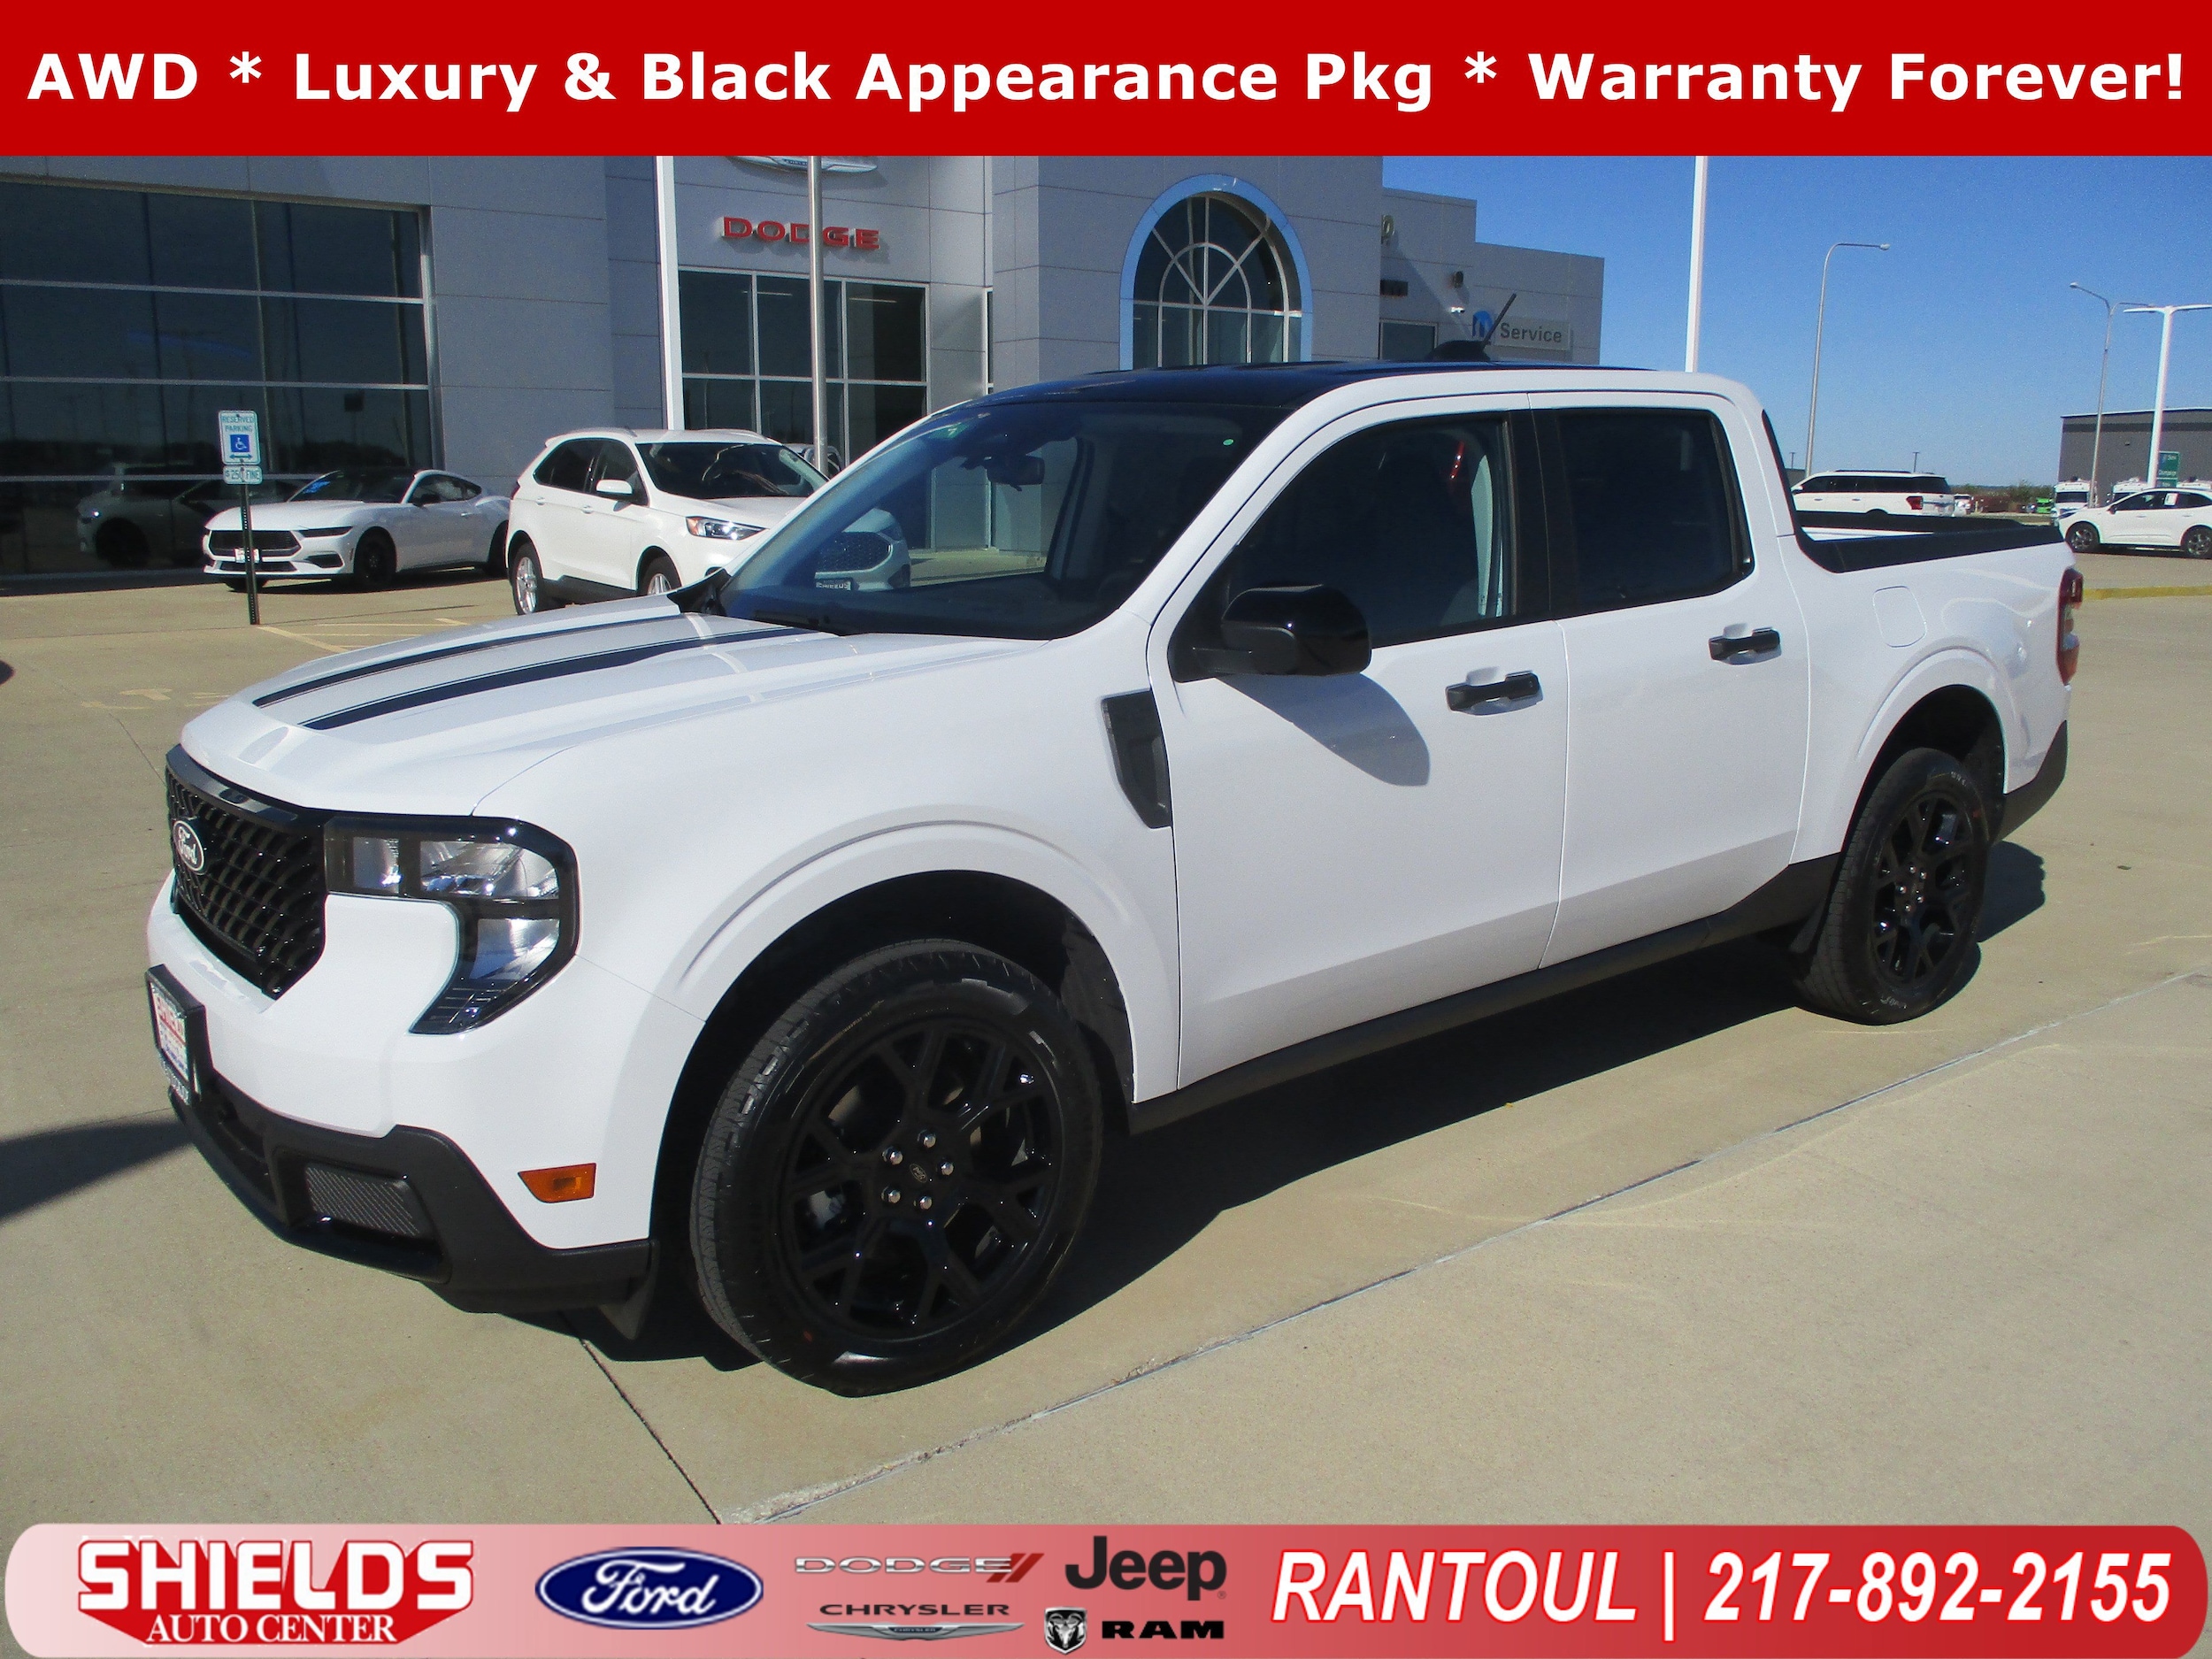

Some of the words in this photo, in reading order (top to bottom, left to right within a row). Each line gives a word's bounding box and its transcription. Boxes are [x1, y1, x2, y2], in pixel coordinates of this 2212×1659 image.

[722, 216, 880, 250] DODGE
[1500, 321, 1563, 343] Service
[178, 826, 198, 865] Ford
